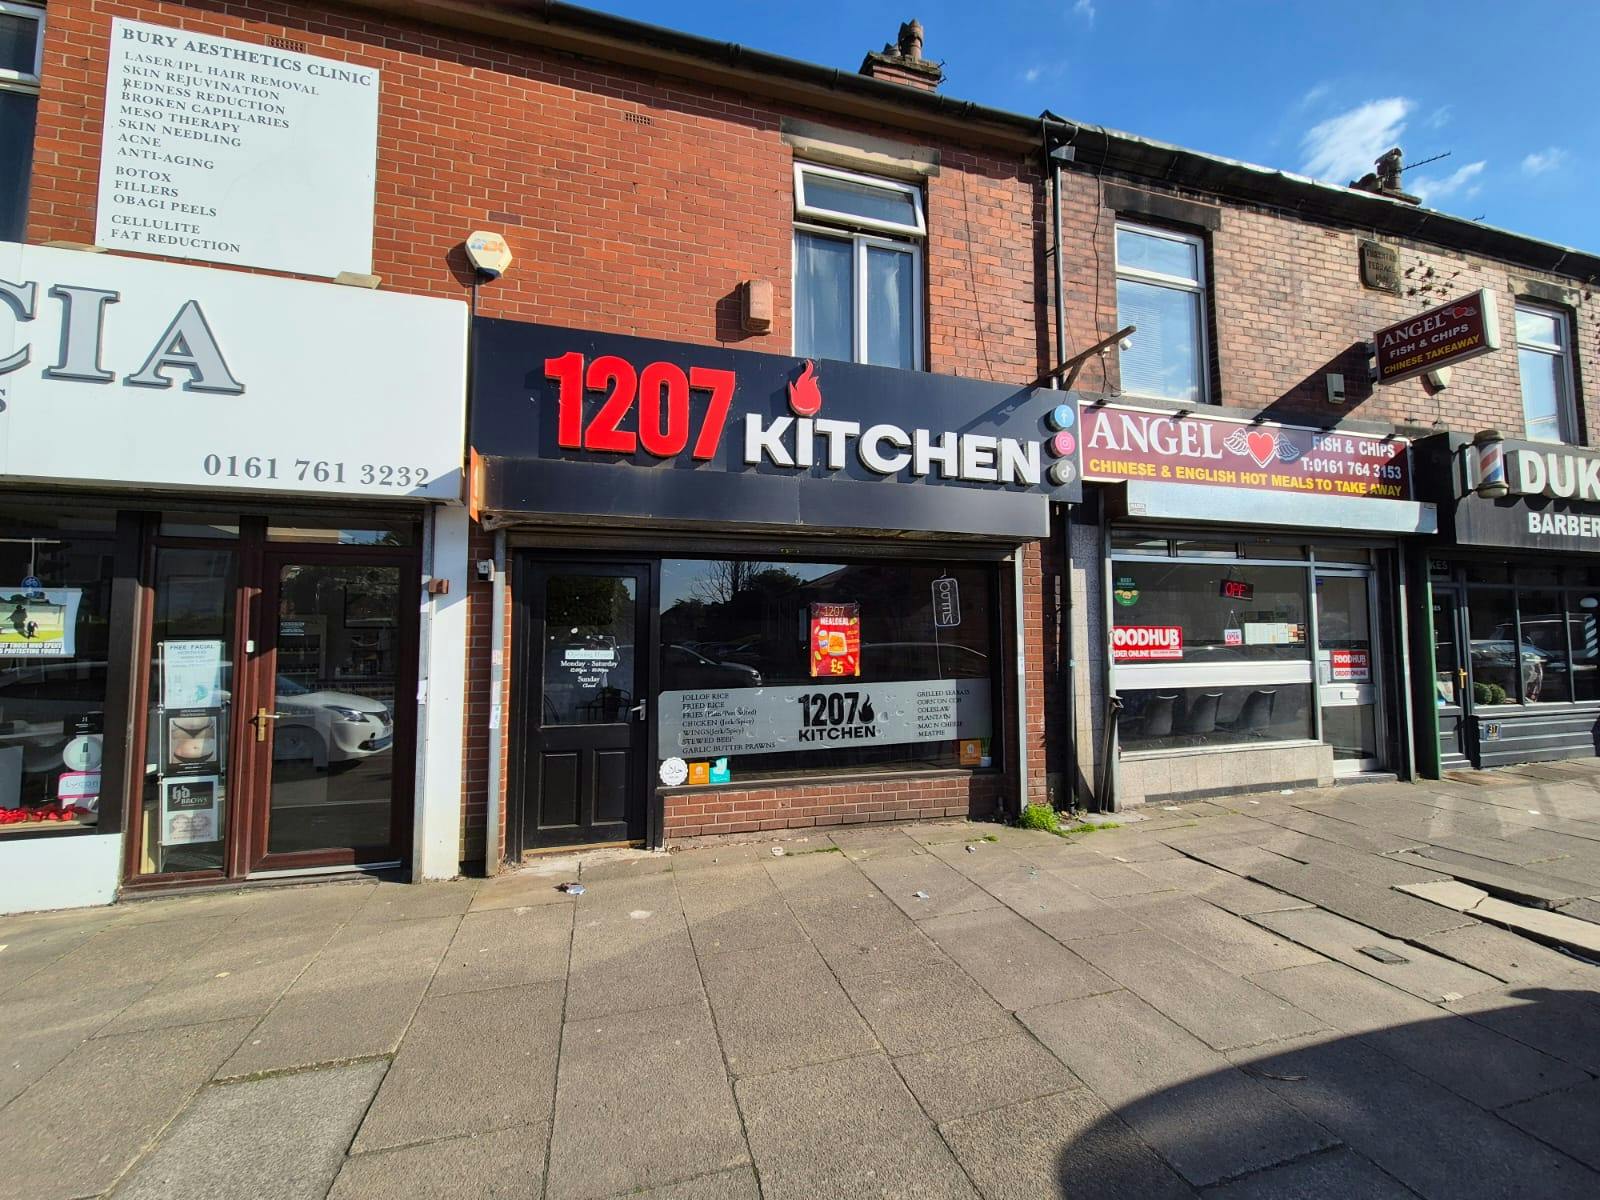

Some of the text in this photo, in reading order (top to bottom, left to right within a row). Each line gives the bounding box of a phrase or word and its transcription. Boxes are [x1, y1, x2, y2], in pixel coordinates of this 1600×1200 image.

[123, 28, 371, 86] BURY AESTHETICS CLINIC
[123, 65, 280, 100] SKIN REJUVINATION
[125, 51, 320, 96] LASER/IPL HAIR REMOVAL
[123, 78, 285, 115] REDNESS REDUCTION
[120, 105, 240, 134] MESO THERAPY
[121, 91, 290, 129] BROKEN CAPILLARIES
[118, 133, 161, 148] ACNE
[119, 119, 242, 148] SKIN NEEDLING
[117, 146, 215, 170] ANTI-AGING
[116, 165, 172, 183] BOTOX
[114, 180, 179, 198] FILLERS
[113, 193, 217, 217] OBAGI PEELS
[111, 214, 201, 235] CELLULITE
[111, 228, 241, 253] FAT REDUCTION
[1382, 314, 1446, 348] ANGEL
[1390, 324, 1469, 359] FISH & CHIPS
[1384, 335, 1480, 374] CHINESE TAKEAWAY
[545, 351, 1040, 485] 1207 KITCHEN
[1088, 412, 1222, 459] ANGEL
[1312, 435, 1395, 459] FISH & CHIPS
[204, 453, 429, 488] 0161 761 3232
[1090, 459, 1402, 497] CHINESE & ENGLISH HOT MEALS TO TAKE AWAY
[1301, 457, 1402, 480] T:0161 764 3153
[1518, 449, 1600, 501] DUK
[560, 660, 586, 668] Monday
[591, 660, 618, 669] Saturday
[831, 659, 844, 674] £5
[1334, 654, 1366, 664] FOODHUB
[577, 676, 600, 684] Sunday
[681, 694, 710, 702] JOLLOF
[707, 701, 725, 709] RICE
[798, 691, 859, 728] 1207
[917, 706, 951, 714] COLESLAW
[682, 711, 703, 719] FRIES
[682, 719, 717, 727] CHICKEN
[682, 737, 714, 745] STEWED
[799, 725, 876, 742] KITCHEN
[682, 742, 776, 754] GARLIC BUTTER PRAWNS
